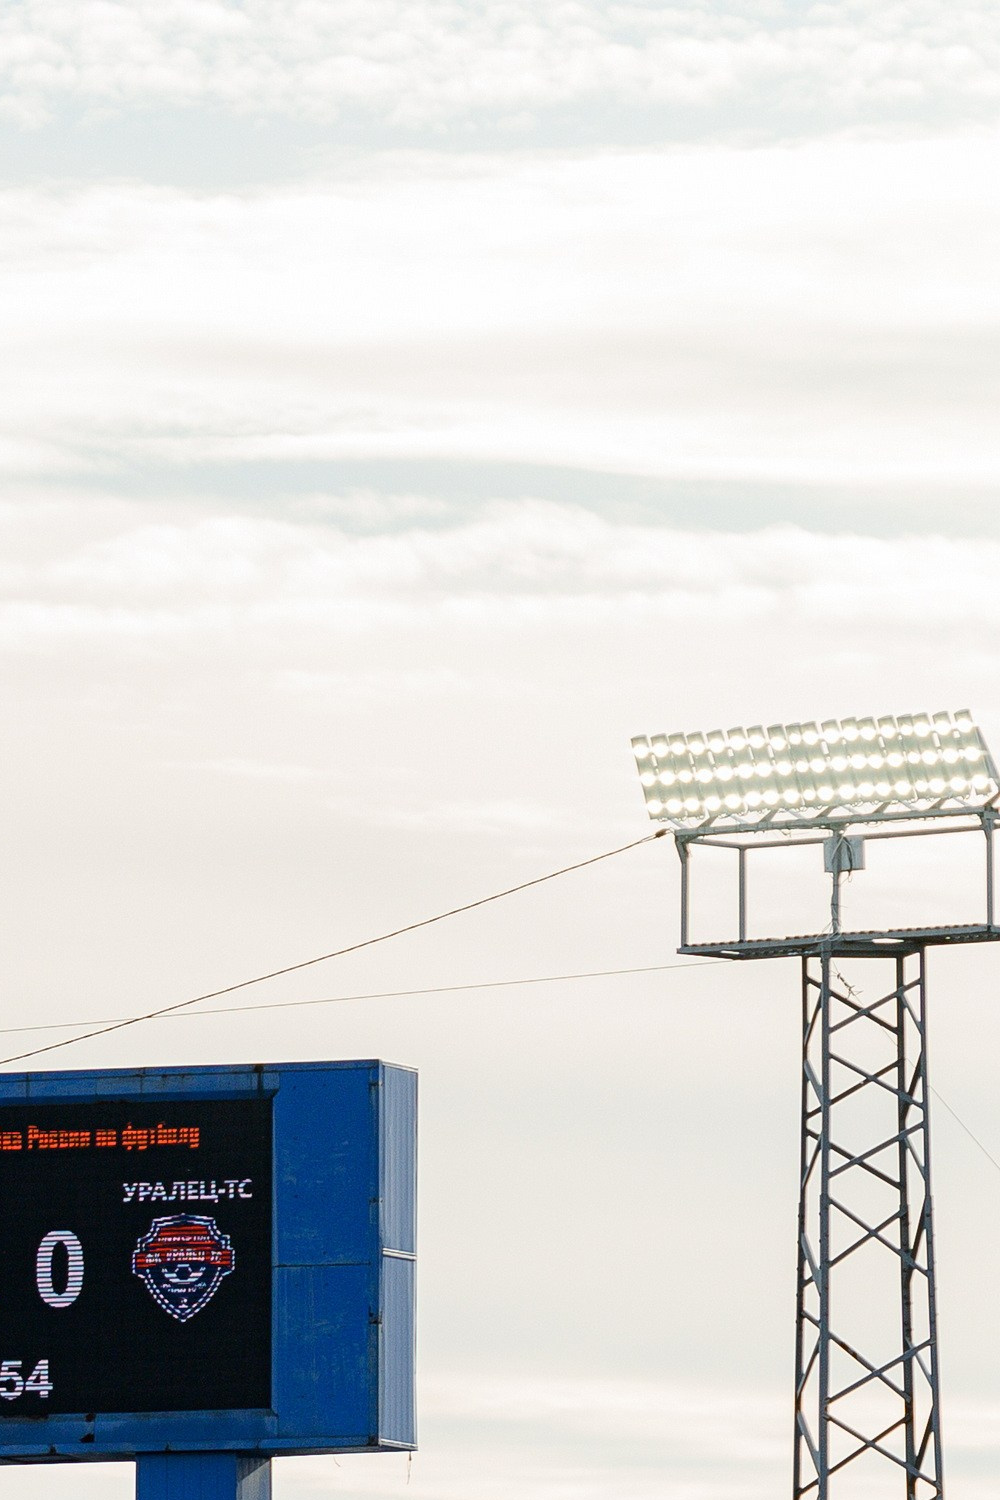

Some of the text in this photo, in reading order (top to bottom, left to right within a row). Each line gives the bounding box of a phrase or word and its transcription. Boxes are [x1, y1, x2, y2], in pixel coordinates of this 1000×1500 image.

[27, 1125, 91, 1150] России
[95, 1128, 117, 1147] по
[122, 1121, 200, 1151] футболу
[122, 1179, 253, 1204] УРАЛЕЦ-ТС
[36, 1230, 85, 1308] 0
